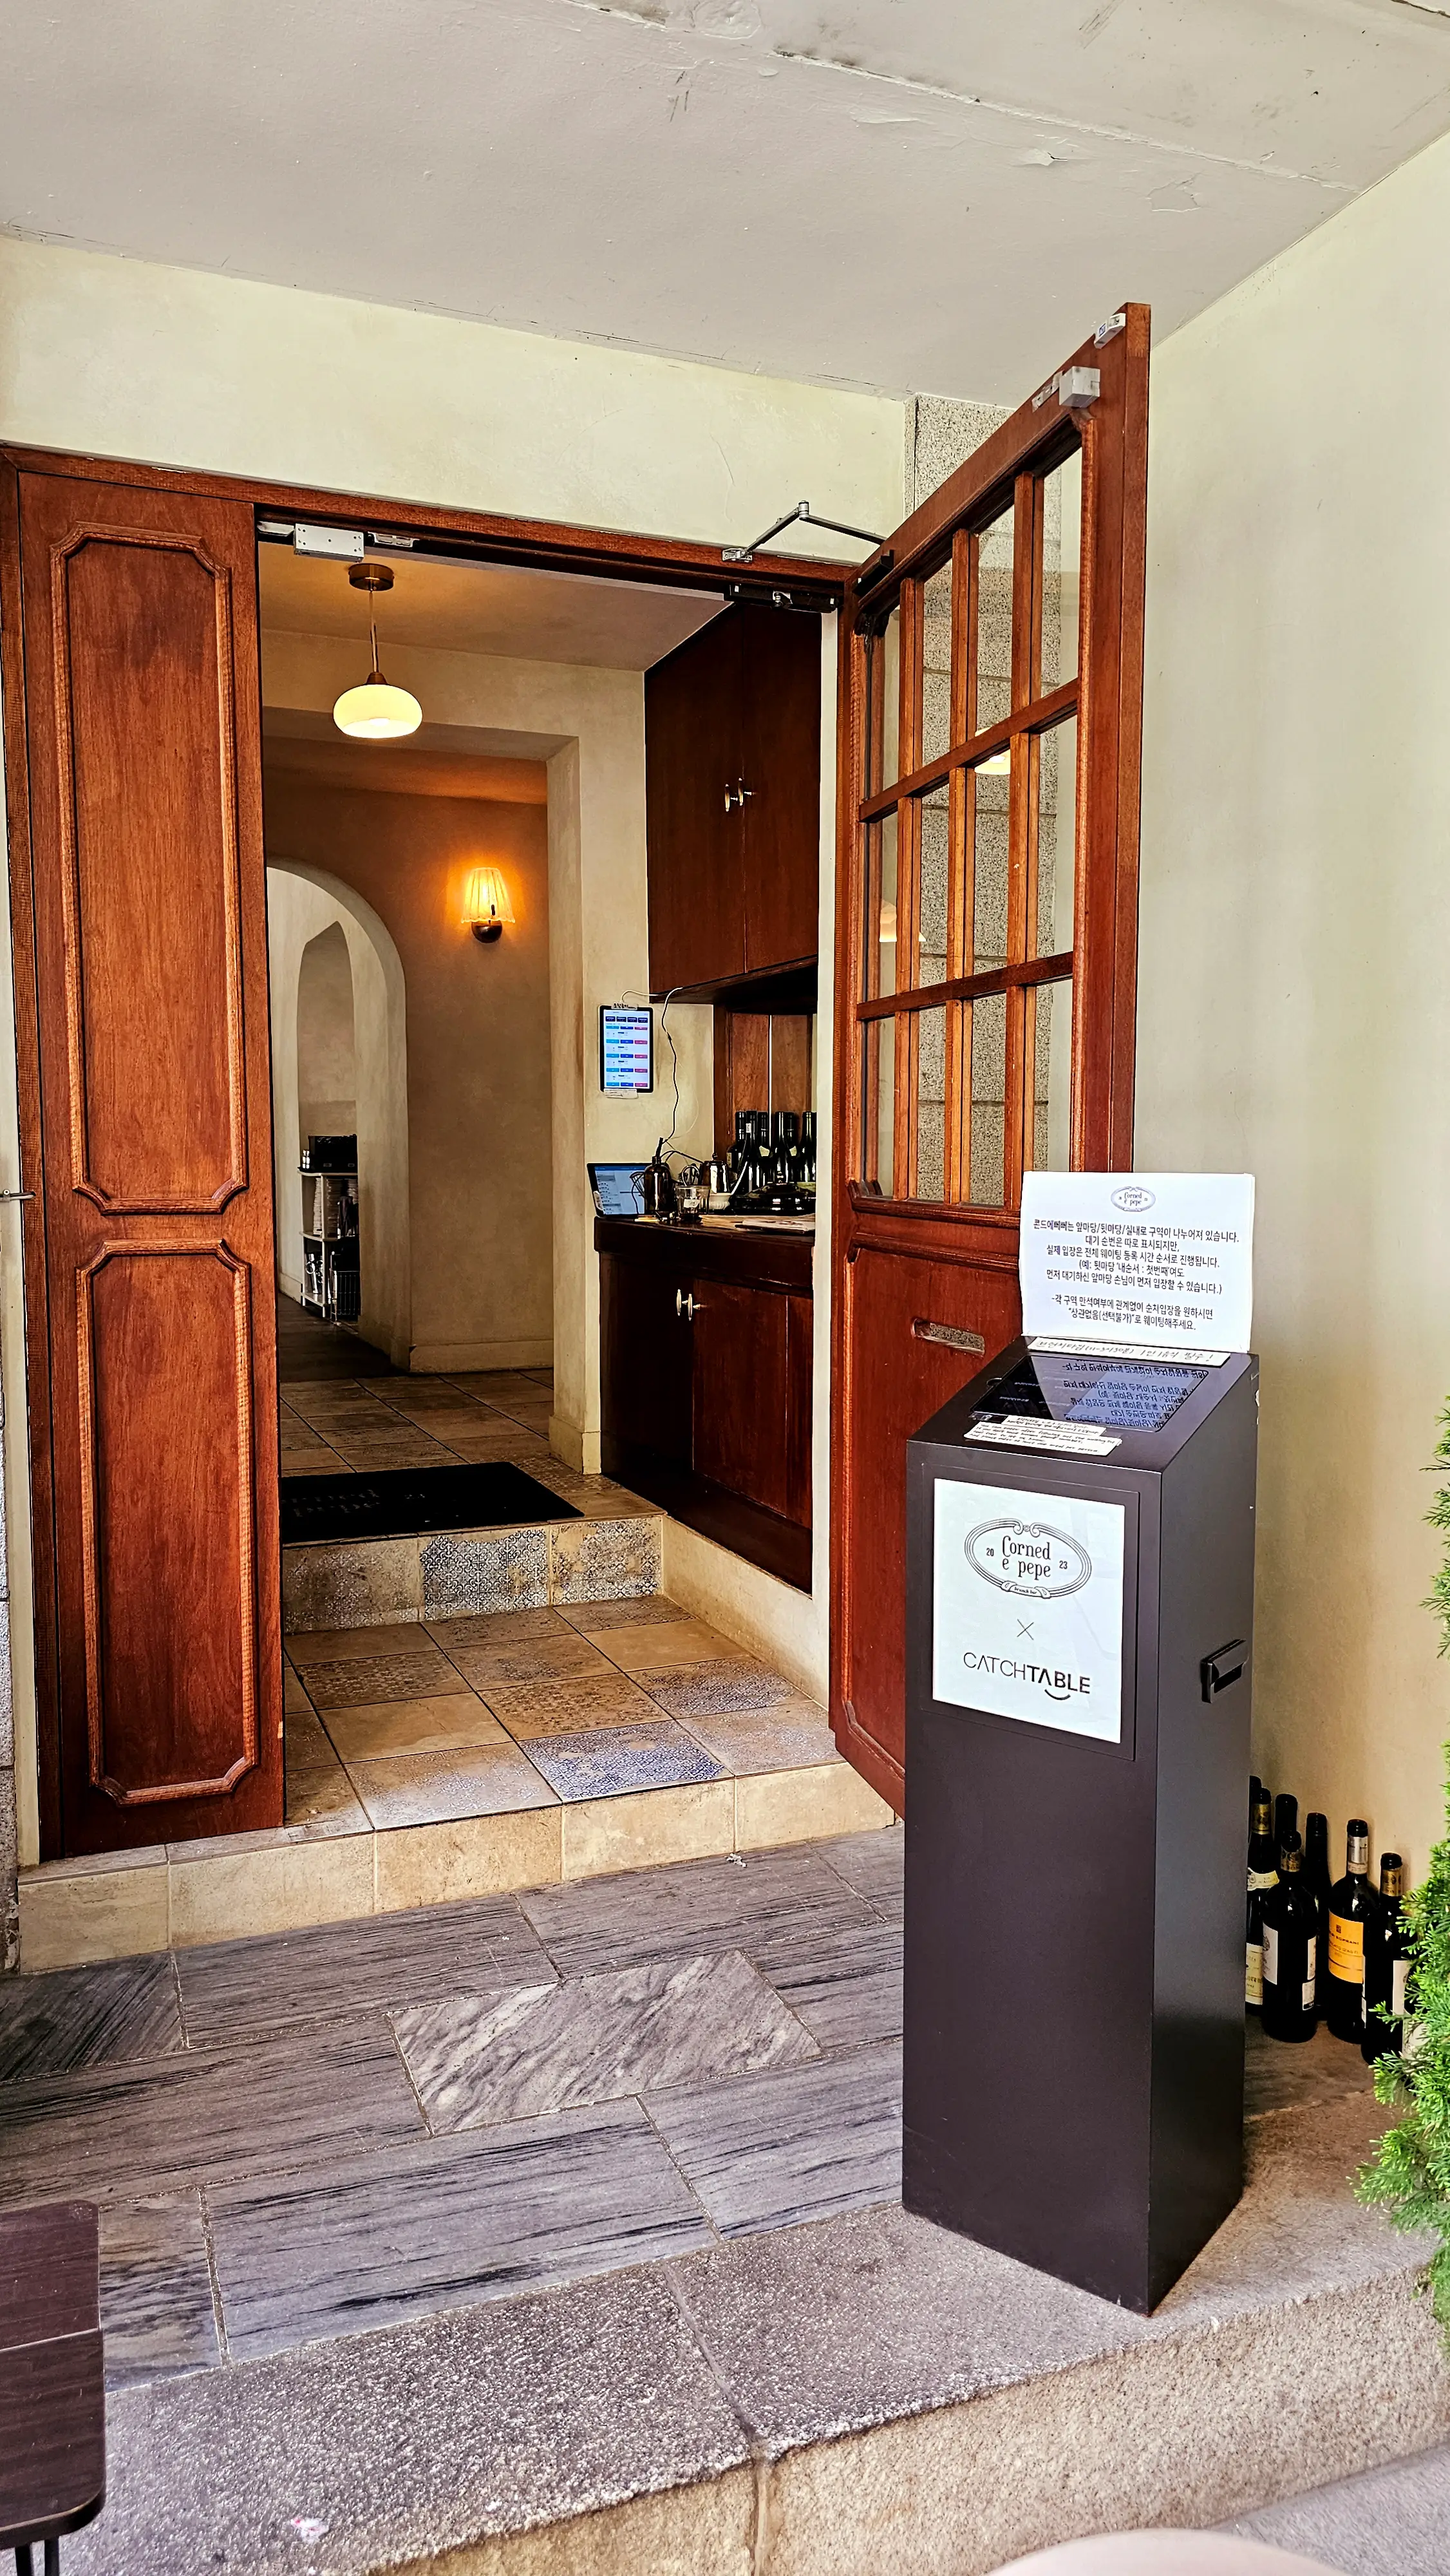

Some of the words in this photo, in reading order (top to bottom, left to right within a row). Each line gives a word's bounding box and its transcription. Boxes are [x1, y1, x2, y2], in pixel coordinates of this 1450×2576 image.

[1076, 1222, 1147, 1236] 앞마당/뒷마당/실내로
[1149, 1227, 1171, 1238] 구역이
[1173, 1228, 1203, 1241] 나누어져
[1205, 1230, 1239, 1243] 있습니다.
[1086, 1235, 1099, 1245] 대기
[1101, 1236, 1123, 1247] 순번은
[1125, 1238, 1139, 1248] 따로
[1047, 1245, 1060, 1256] 실제
[1062, 1245, 1083, 1257] 입장은
[1085, 1247, 1098, 1258] 전체
[1100, 1249, 1122, 1260] 웨이팅
[1124, 1251, 1138, 1262] 등록
[1140, 1252, 1154, 1263] 시간
[1156, 1253, 1178, 1264] 순서로
[1180, 1255, 1219, 1268] 진행됩니다.
[1094, 1261, 1115, 1273] 뒷마당
[1047, 1269, 1060, 1280] 먼저
[1062, 1271, 1089, 1282] 대기하신
[1091, 1273, 1112, 1285] 앞마당
[1114, 1275, 1135, 1287] 손님이
[1137, 1277, 1151, 1288] 먼저
[1154, 1278, 1175, 1291] 입장할
[1177, 1281, 1184, 1291] 수
[1064, 1296, 1077, 1306] 구역
[1079, 1297, 1114, 1309] 만석여부에
[1116, 1300, 1144, 1312] 관계없이
[1183, 1307, 1213, 1320] 원하시면
[1002, 1535, 1050, 1560] Corned
[986, 1548, 994, 1557] 20
[1002, 1558, 1009, 1570] e
[1018, 1562, 1051, 1580] pepe
[1059, 1560, 1068, 1569] 23
[963, 1652, 1091, 1694] CATCHTABLE
